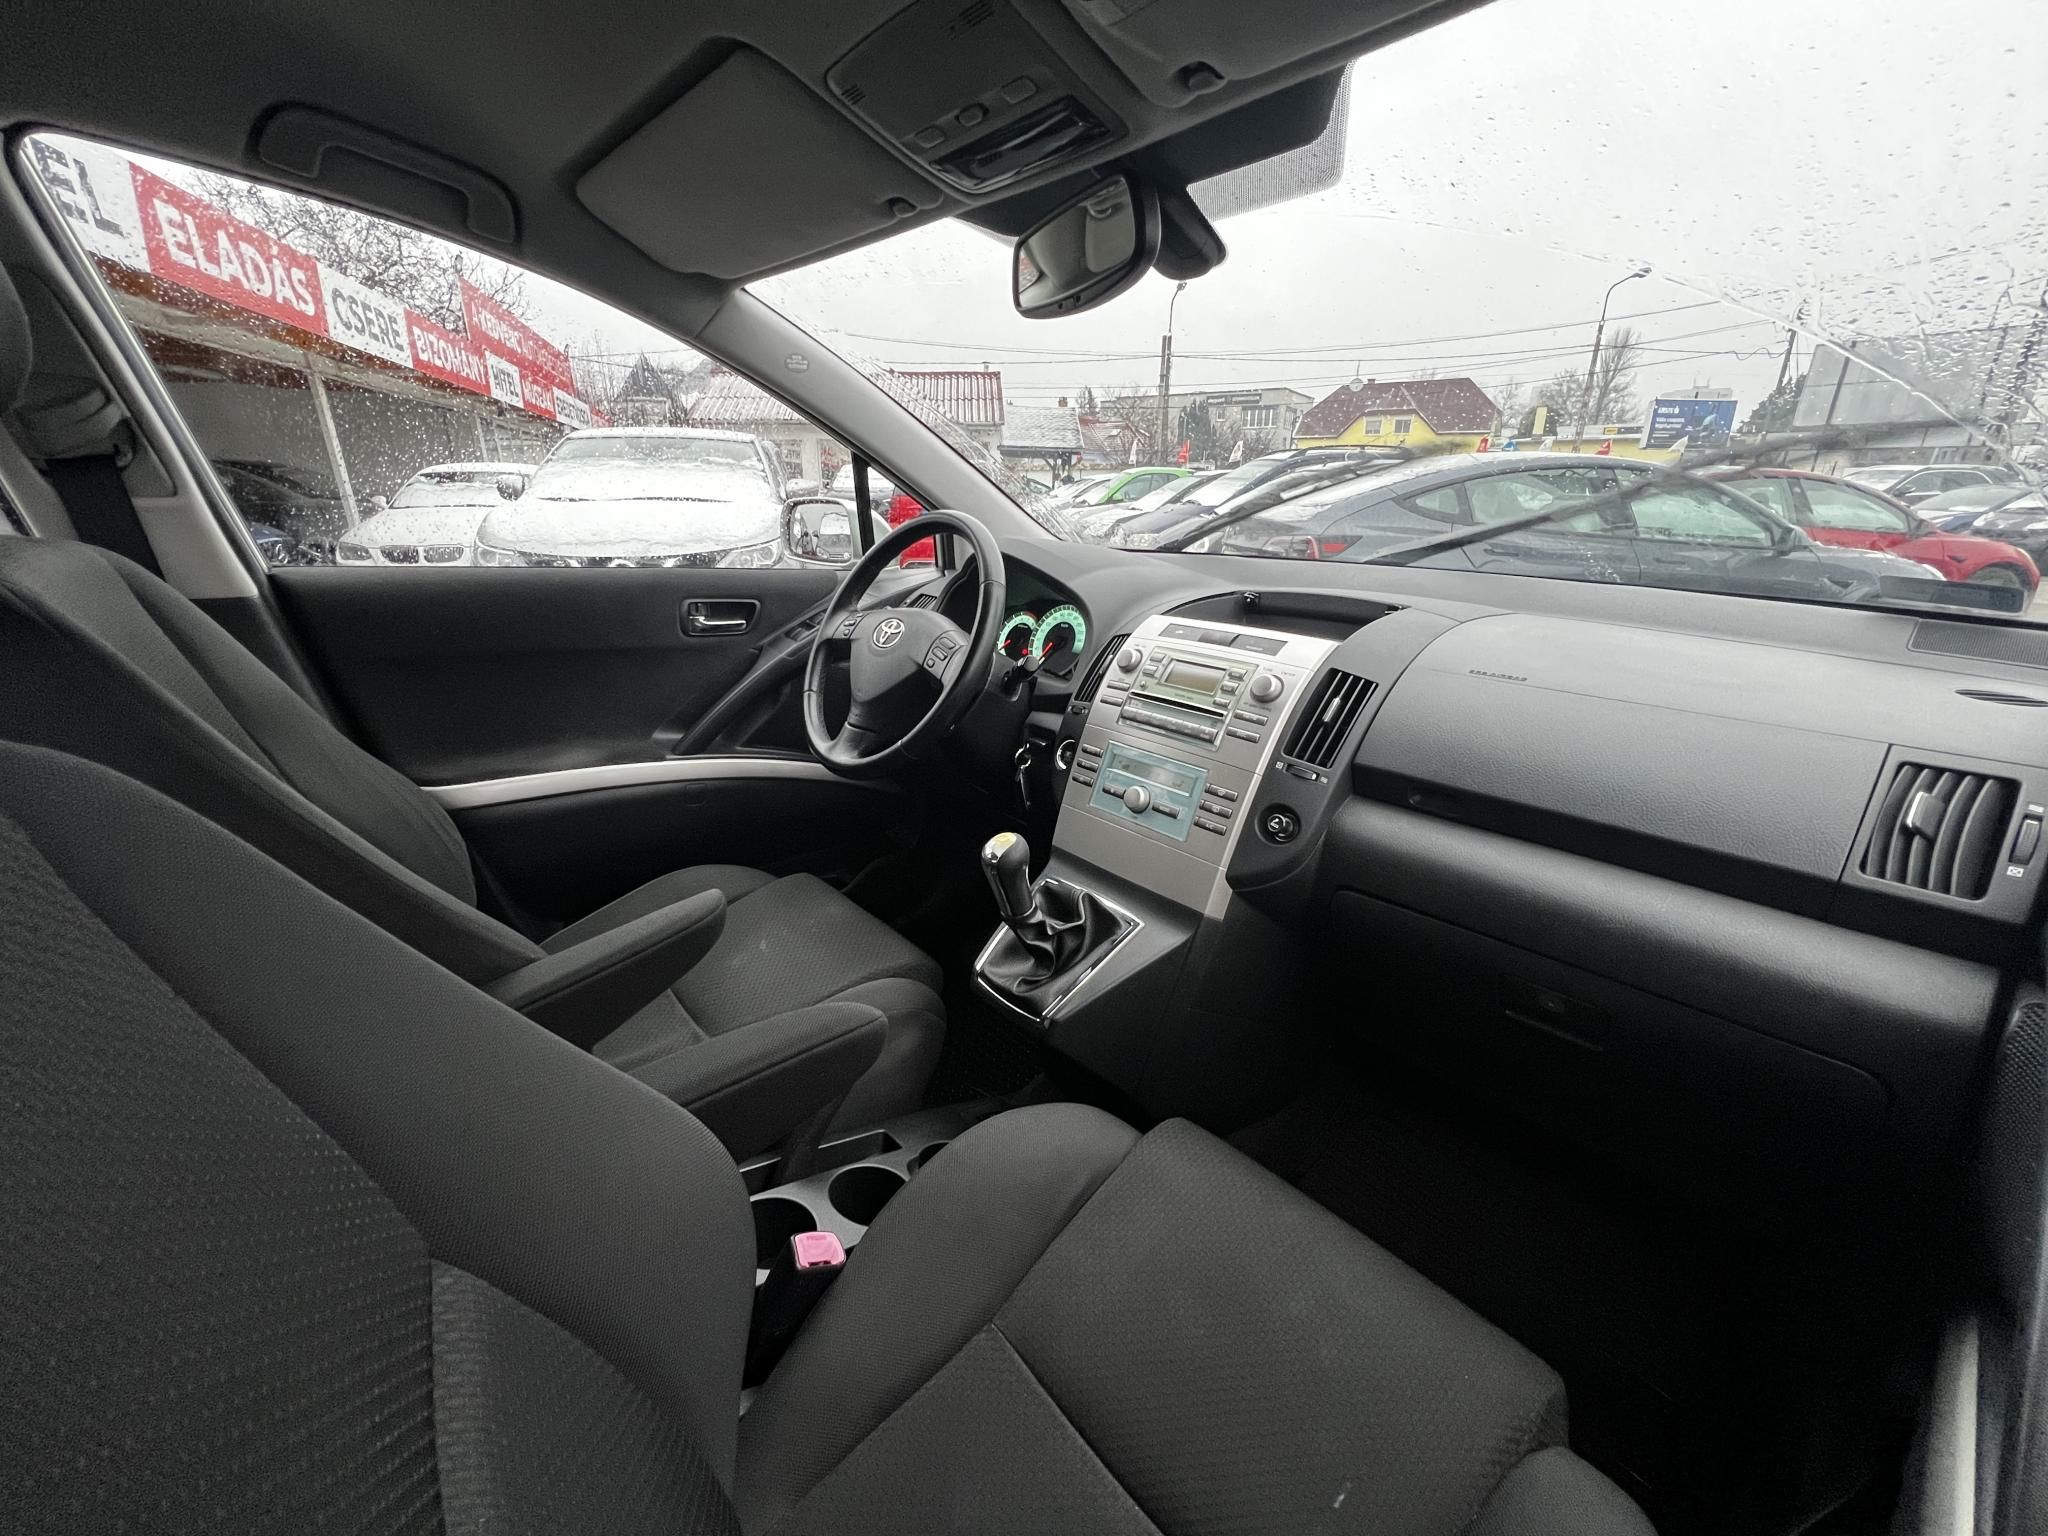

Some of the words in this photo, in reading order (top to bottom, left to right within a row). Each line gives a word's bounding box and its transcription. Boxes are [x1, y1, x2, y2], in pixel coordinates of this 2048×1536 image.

[153, 197, 317, 317] ELADÁS
[331, 286, 406, 352] CSERE
[412, 325, 487, 385] BIZOMÁNY
